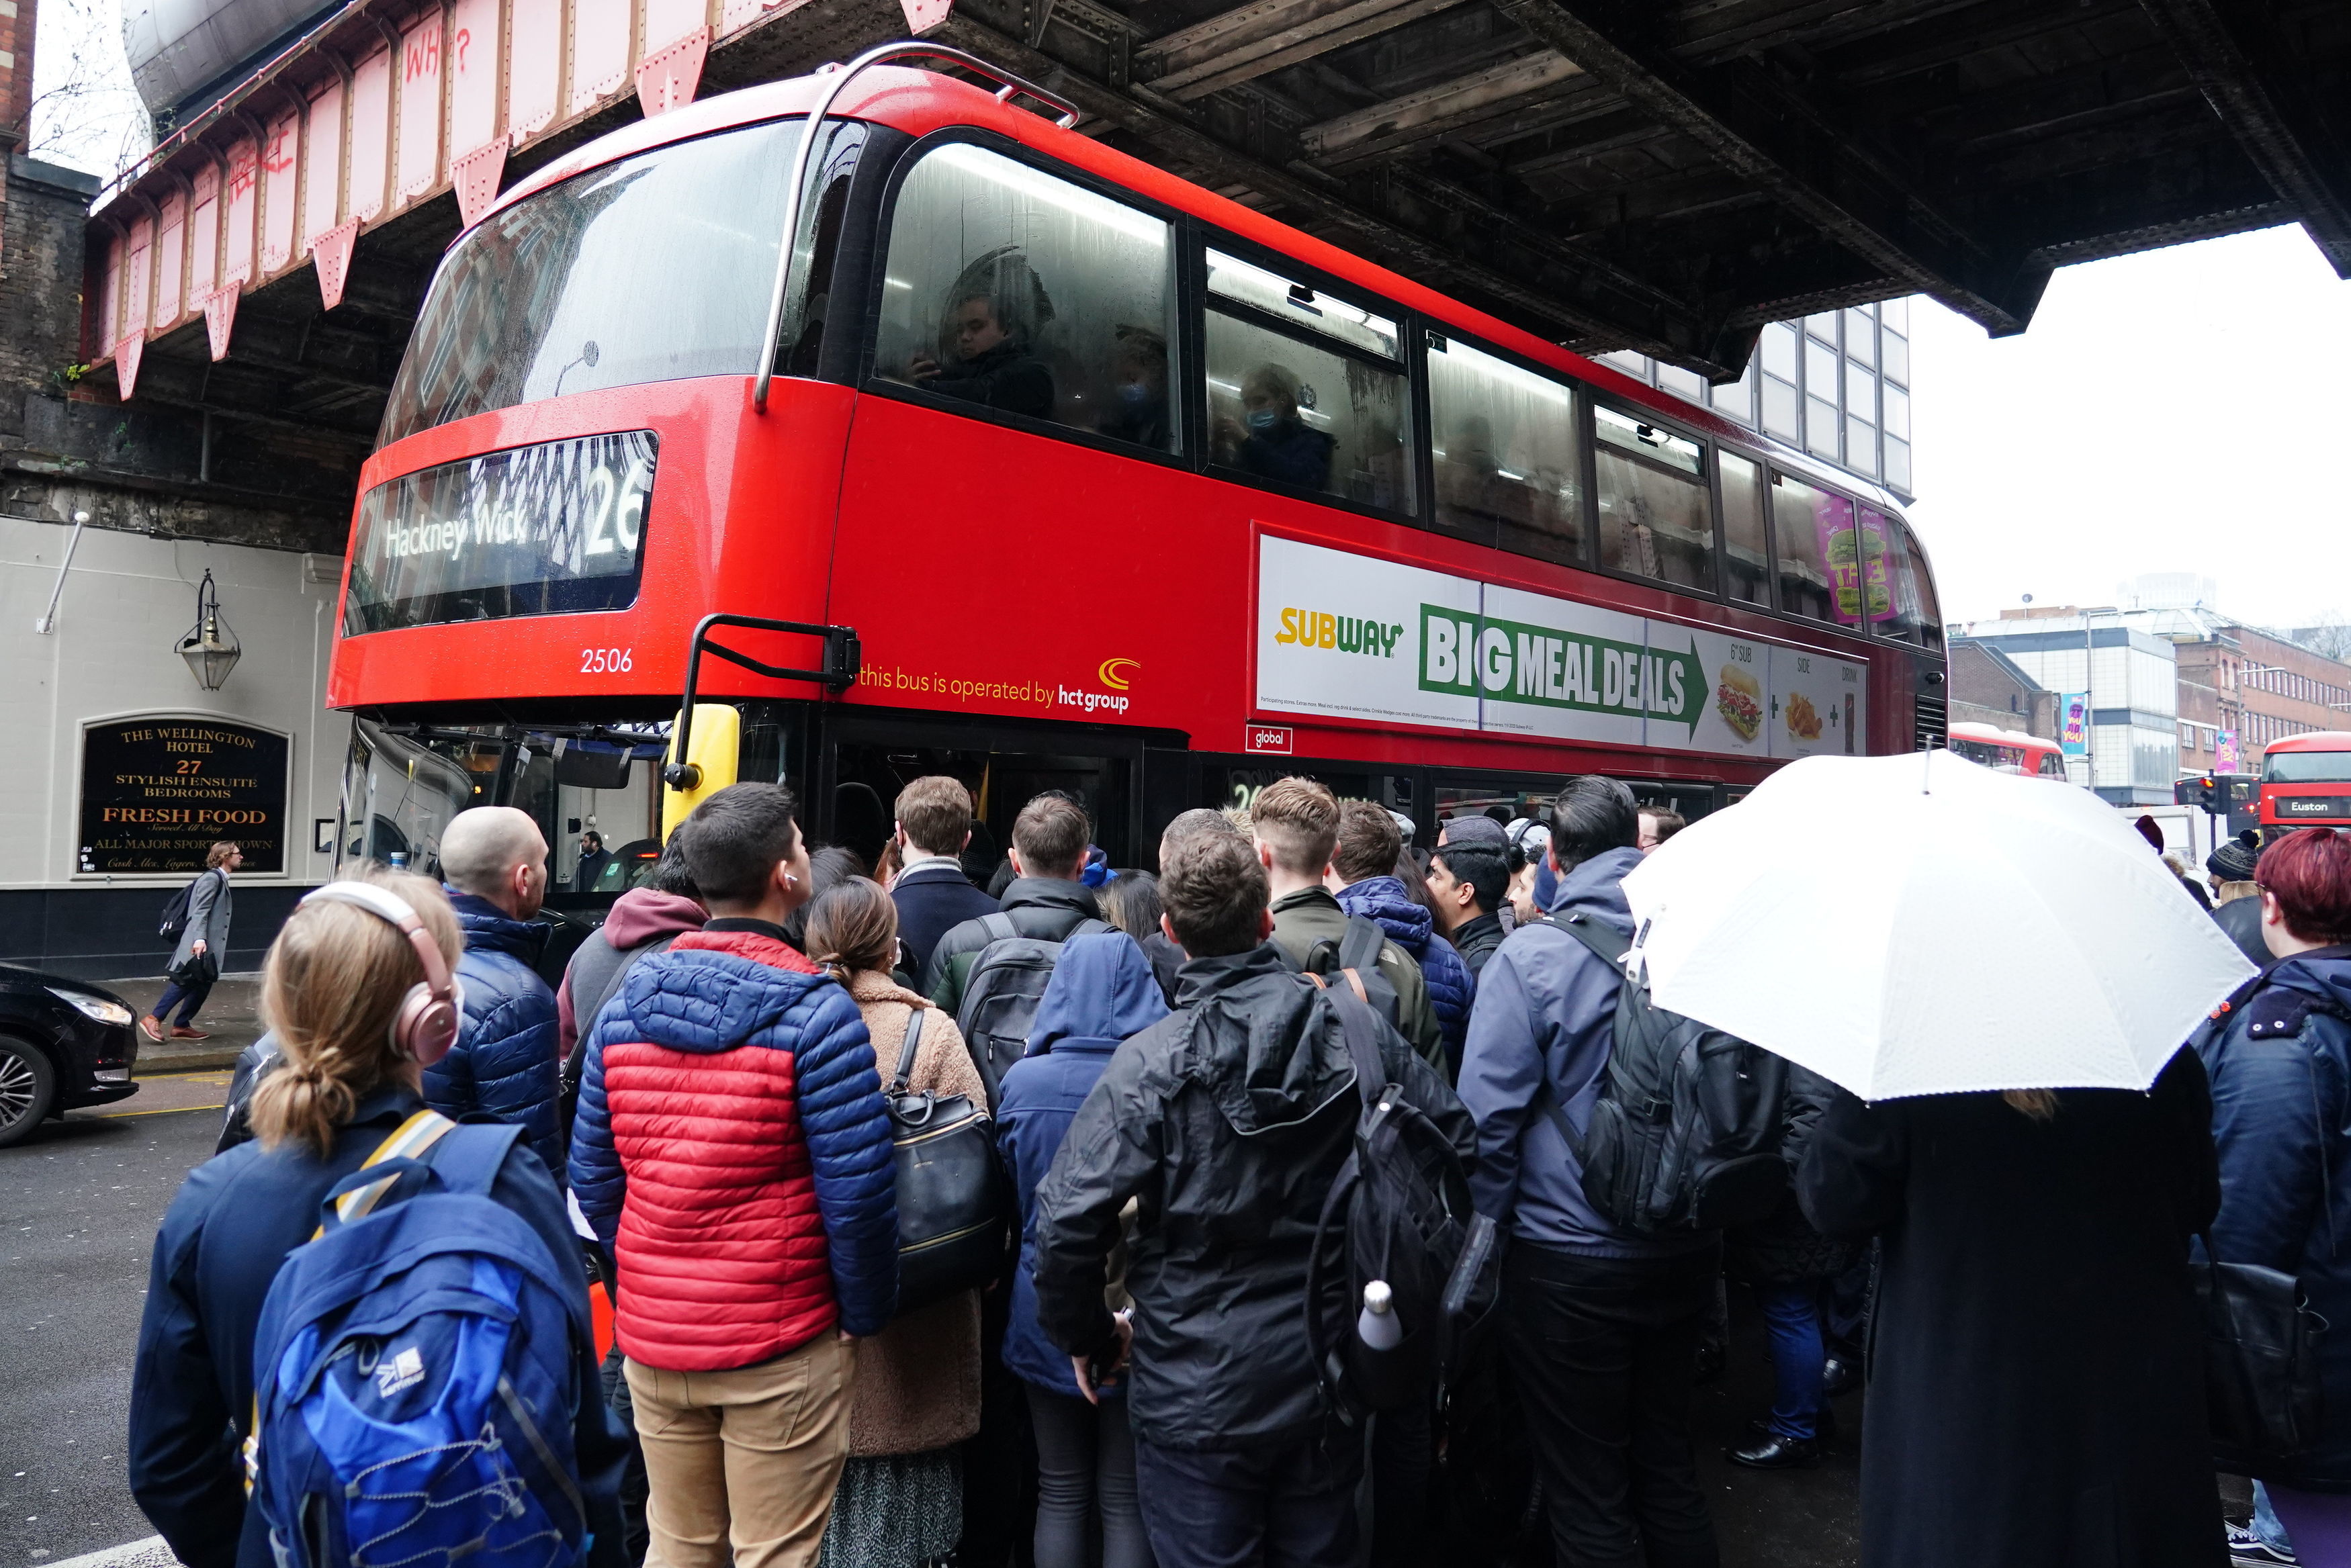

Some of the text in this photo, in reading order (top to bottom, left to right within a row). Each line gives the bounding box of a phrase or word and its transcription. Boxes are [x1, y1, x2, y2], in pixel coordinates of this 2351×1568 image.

[584, 459, 646, 556] 26
[385, 500, 529, 561] Hackney Wick
[1274, 607, 1405, 659] SUBWAY
[580, 647, 634, 674] 2506
[1739, 645, 1752, 663] SUB
[1425, 614, 1685, 716] BIG MEAL DEALS
[1797, 657, 1811, 674] SIDE
[1842, 666, 1858, 684] DRINK
[859, 663, 892, 689] this
[896, 666, 929, 691] bus
[933, 672, 947, 693] is
[950, 680, 1032, 703] operated
[1035, 680, 1055, 709] by
[1261, 696, 1283, 705] Participating
[2068, 717, 2081, 725] YOU
[121, 728, 257, 749] THE WELLINGTON
[1255, 729, 1284, 749] global
[2063, 730, 2084, 743] YOU
[166, 741, 214, 753] HOTEL
[176, 759, 202, 774] 27
[116, 774, 258, 788] STYLISH ENSUITE
[144, 787, 231, 799] BEDROOMS
[2291, 802, 2328, 811] Euston
[102, 807, 267, 825] FRESH FOOD
[148, 823, 224, 834] Served All Day
[94, 839, 122, 849] ALL
[124, 839, 171, 849] MAJOR
[173, 839, 218, 850] SPORT
